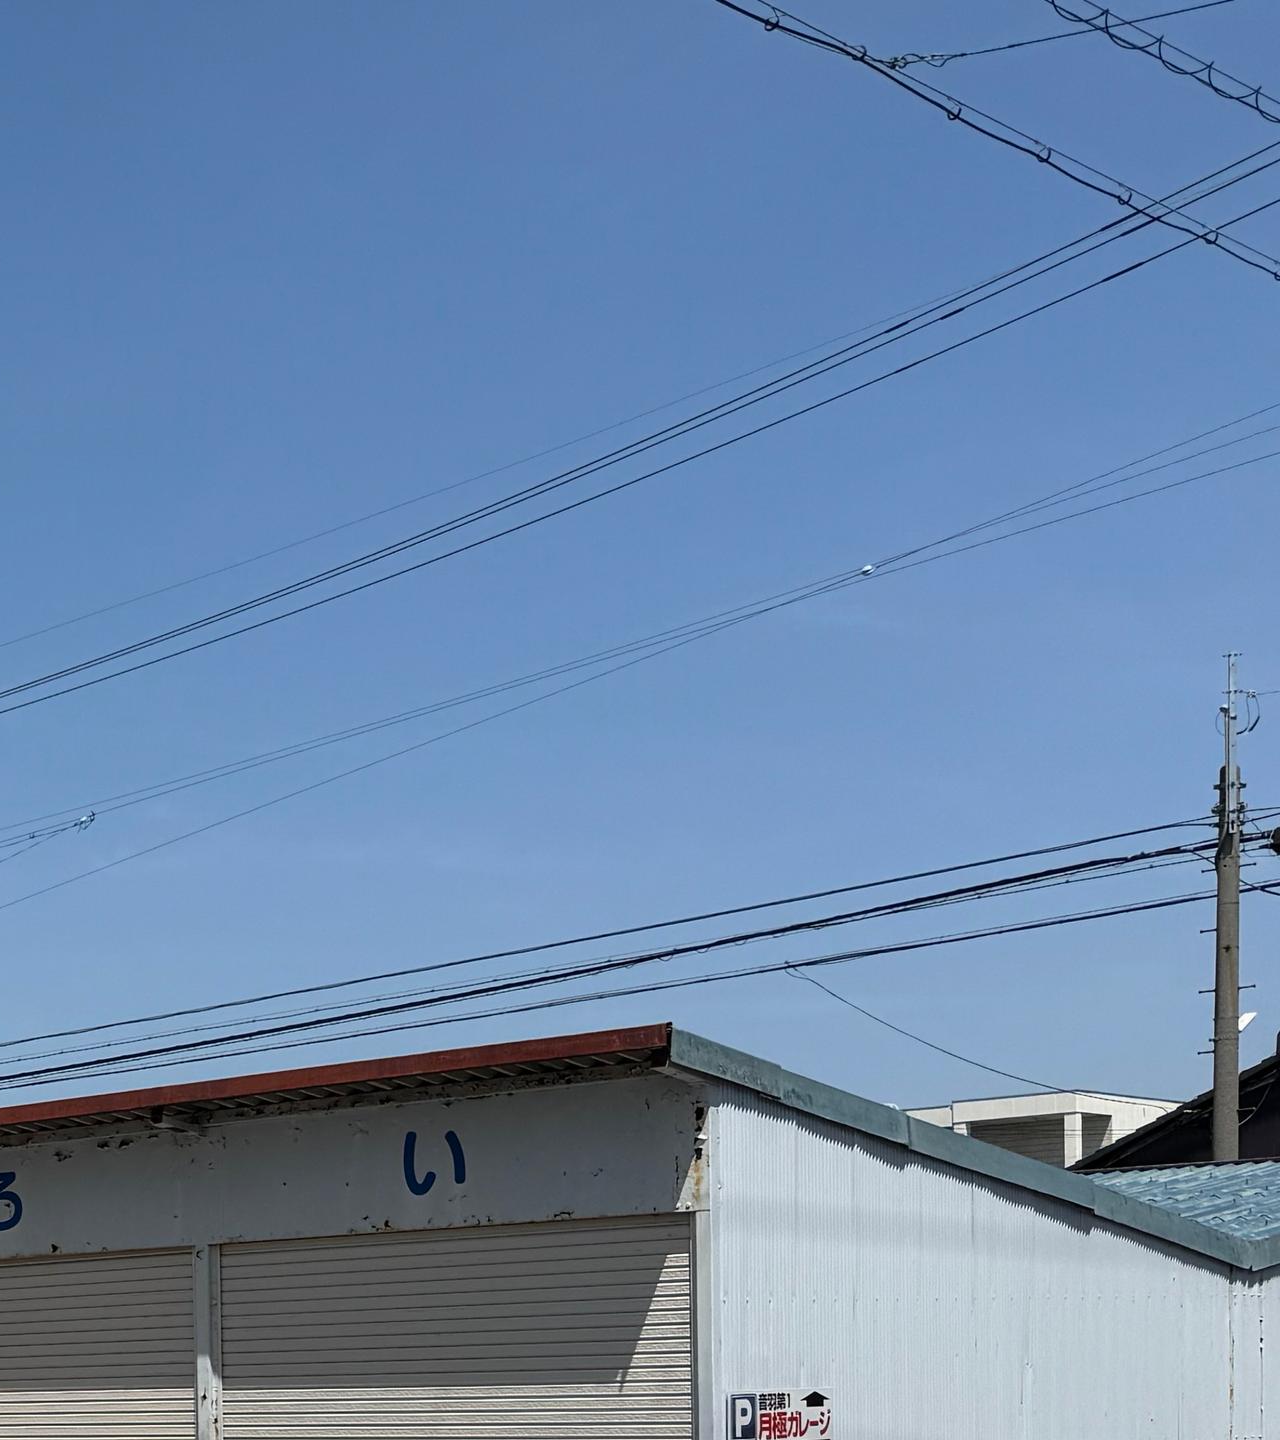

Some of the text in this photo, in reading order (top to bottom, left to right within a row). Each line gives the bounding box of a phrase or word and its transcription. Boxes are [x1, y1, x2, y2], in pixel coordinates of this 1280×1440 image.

[403, 1130, 467, 1196] い
[734, 1398, 753, 1438] P
[759, 1408, 832, 1440] 月極ガレージ
